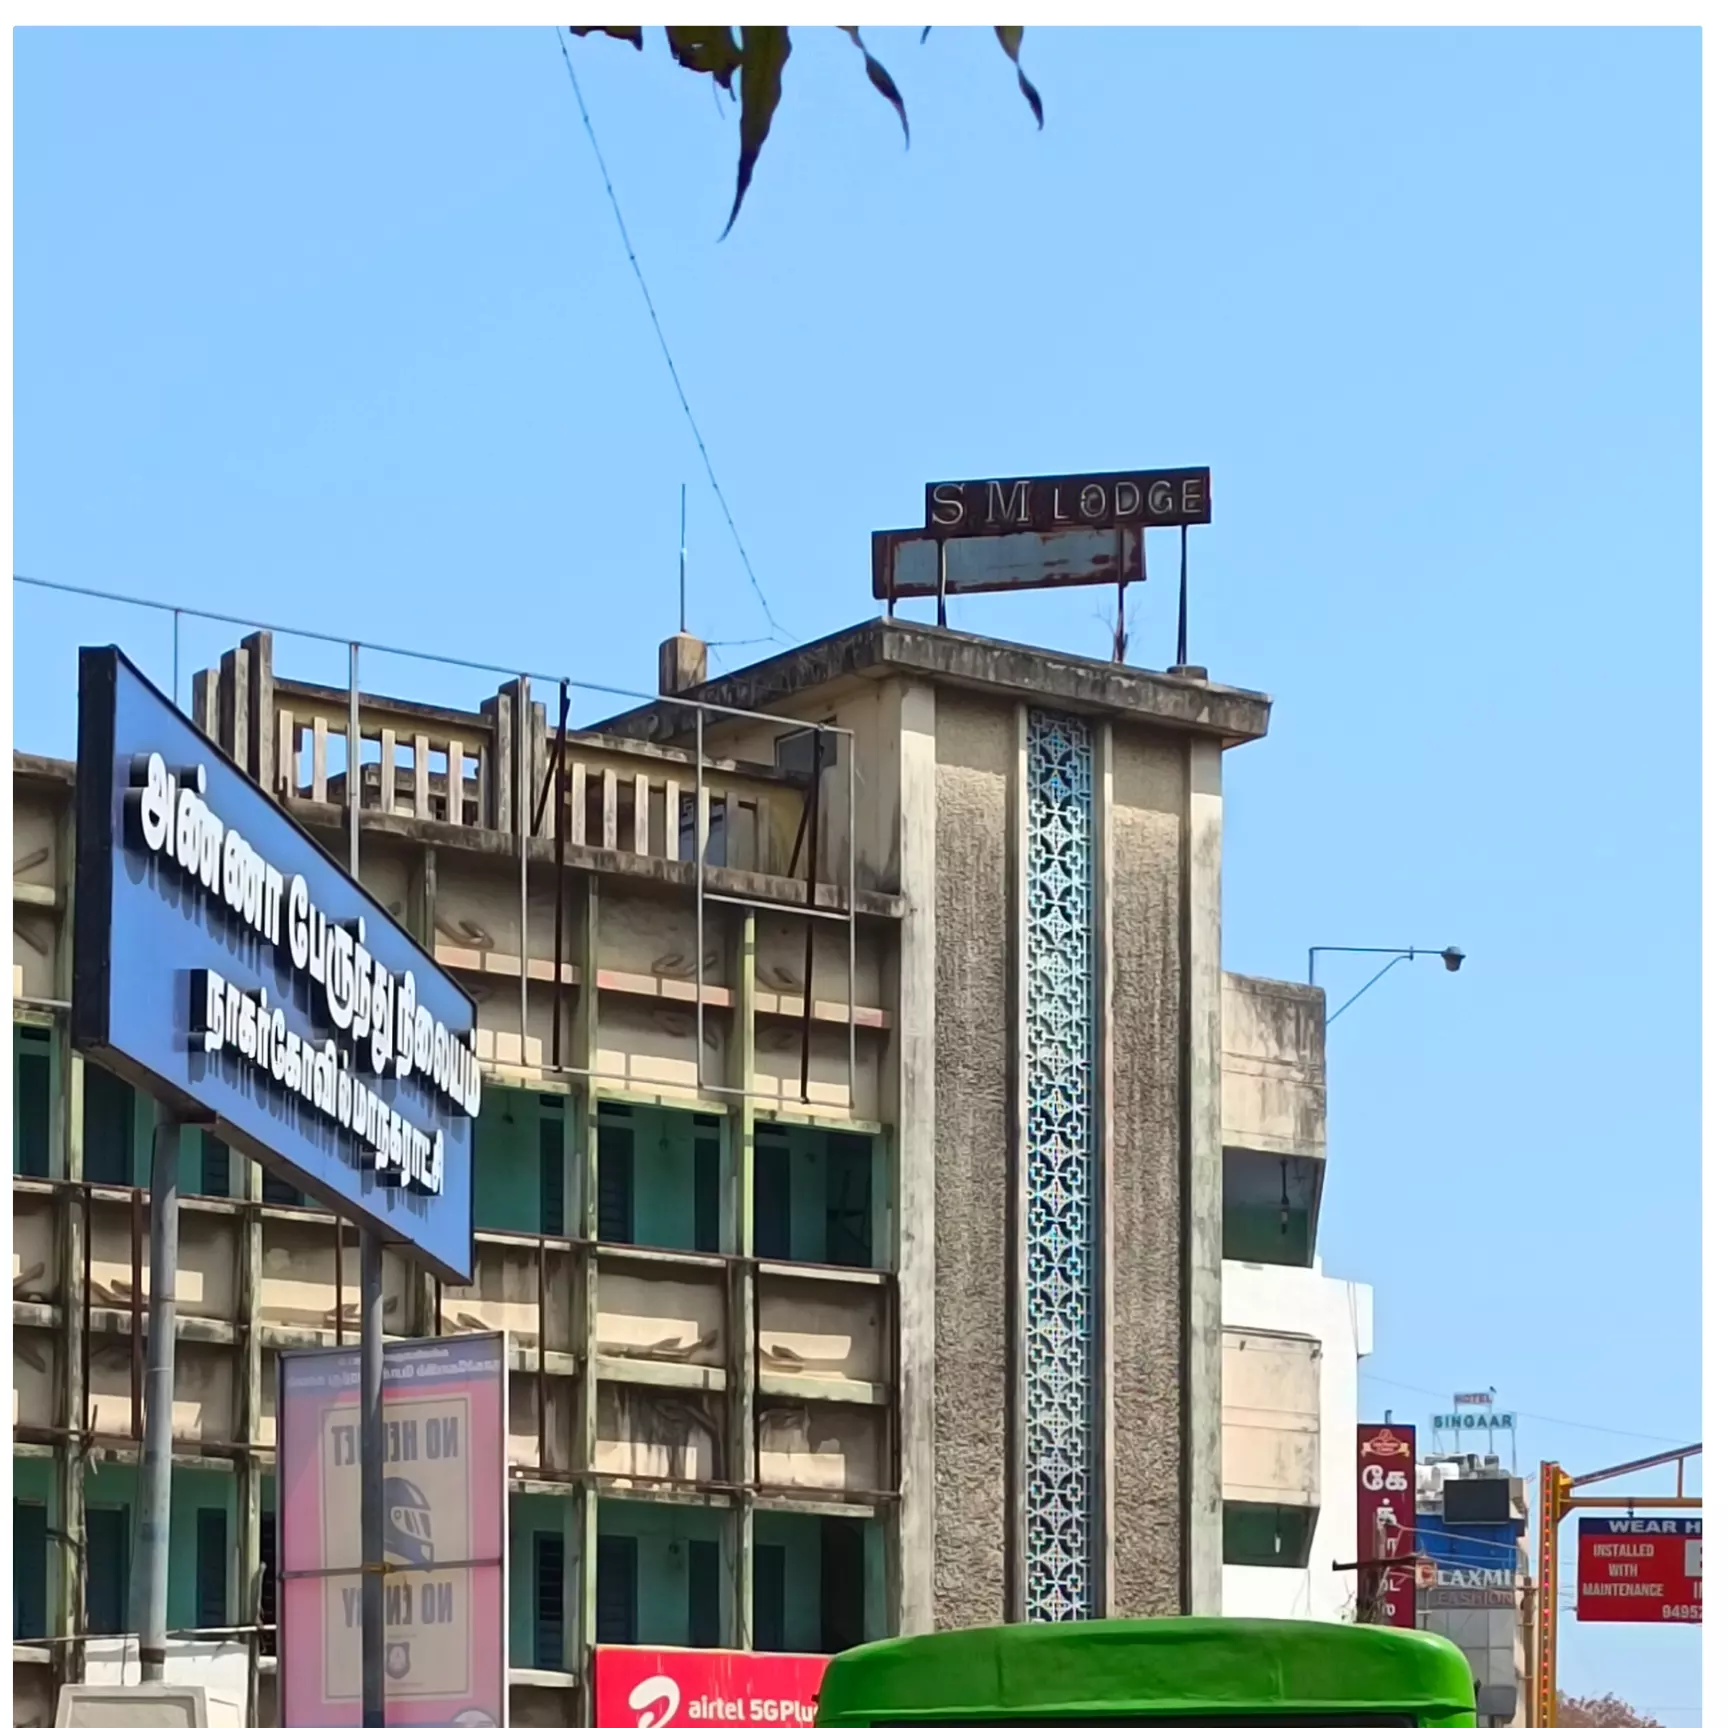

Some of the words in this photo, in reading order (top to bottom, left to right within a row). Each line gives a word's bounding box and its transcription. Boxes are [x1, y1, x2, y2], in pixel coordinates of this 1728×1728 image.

[1054, 479, 1202, 520] LODGE
[141, 752, 284, 945] அண்ணா
[289, 874, 395, 1074] பேருந்து
[396, 970, 481, 1118] நிலையம்
[206, 969, 351, 1129] நாகர்கோவில்
[351, 1078, 444, 1196] மாநகராட்சி
[1433, 1414, 1512, 1429] SINGAAR
[1608, 1520, 1677, 1533] WEAR
[1685, 1520, 1701, 1533] H
[1593, 1543, 1654, 1557] INSTALLED
[1438, 1568, 1512, 1587] LAXMI
[1608, 1563, 1638, 1577] WITH
[1583, 1583, 1664, 1597] MAINTENANCE
[688, 1697, 746, 1721] airtel
